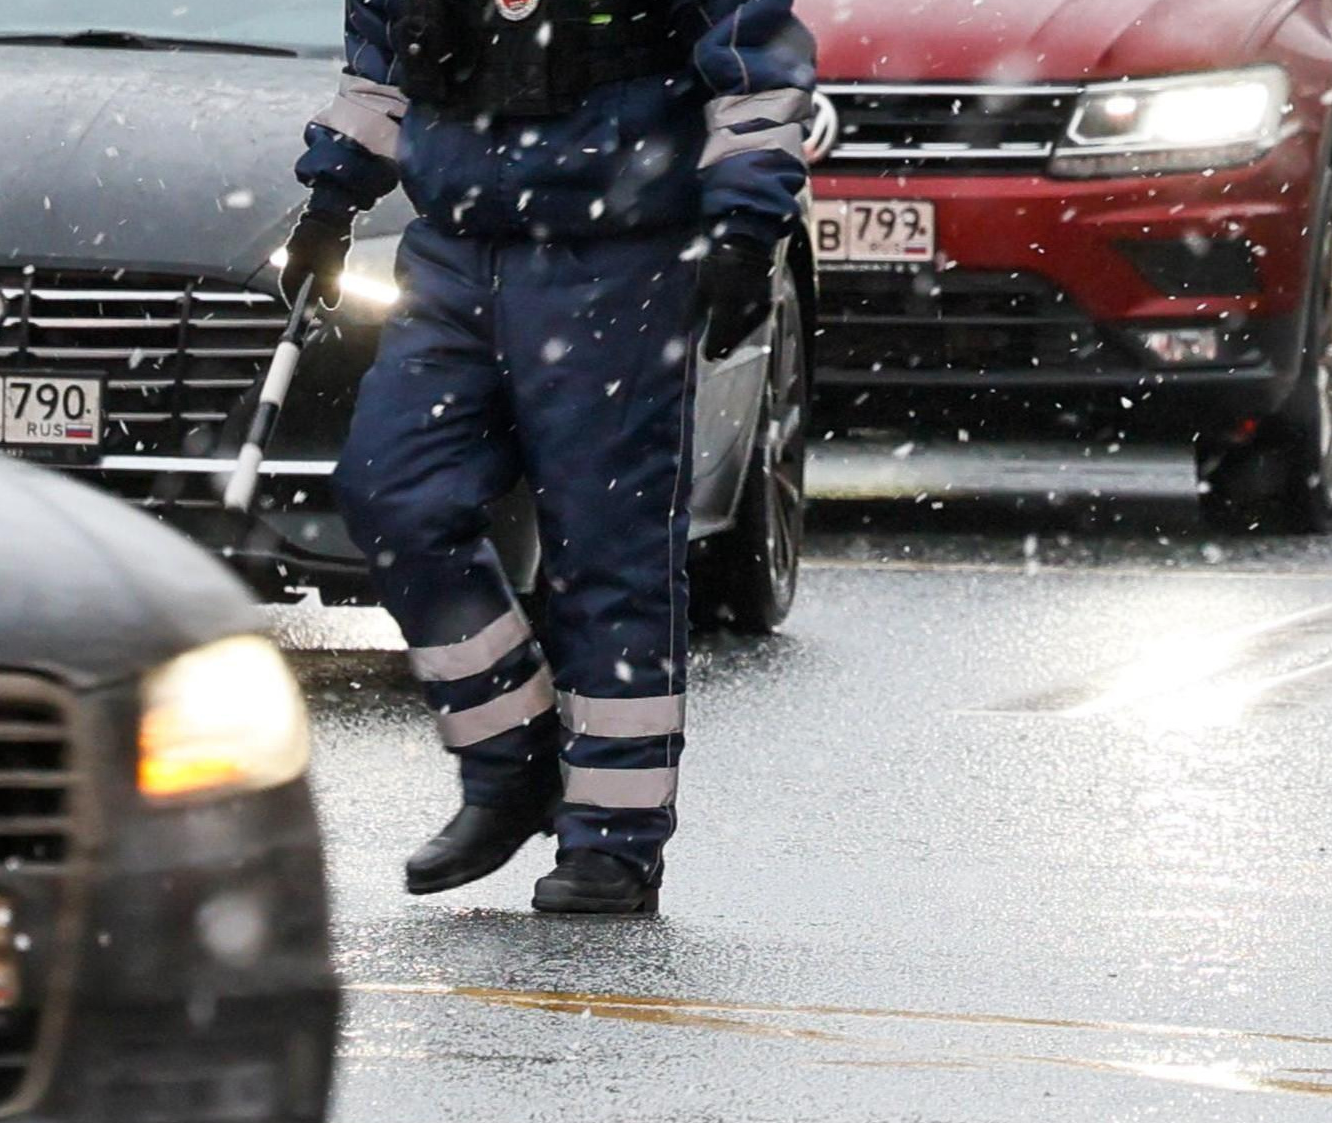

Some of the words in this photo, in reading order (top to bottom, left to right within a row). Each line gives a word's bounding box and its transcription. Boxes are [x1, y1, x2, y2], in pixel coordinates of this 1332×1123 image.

[854, 207, 921, 241] 799
[9, 382, 86, 421] 790
[27, 422, 64, 438] RUS
